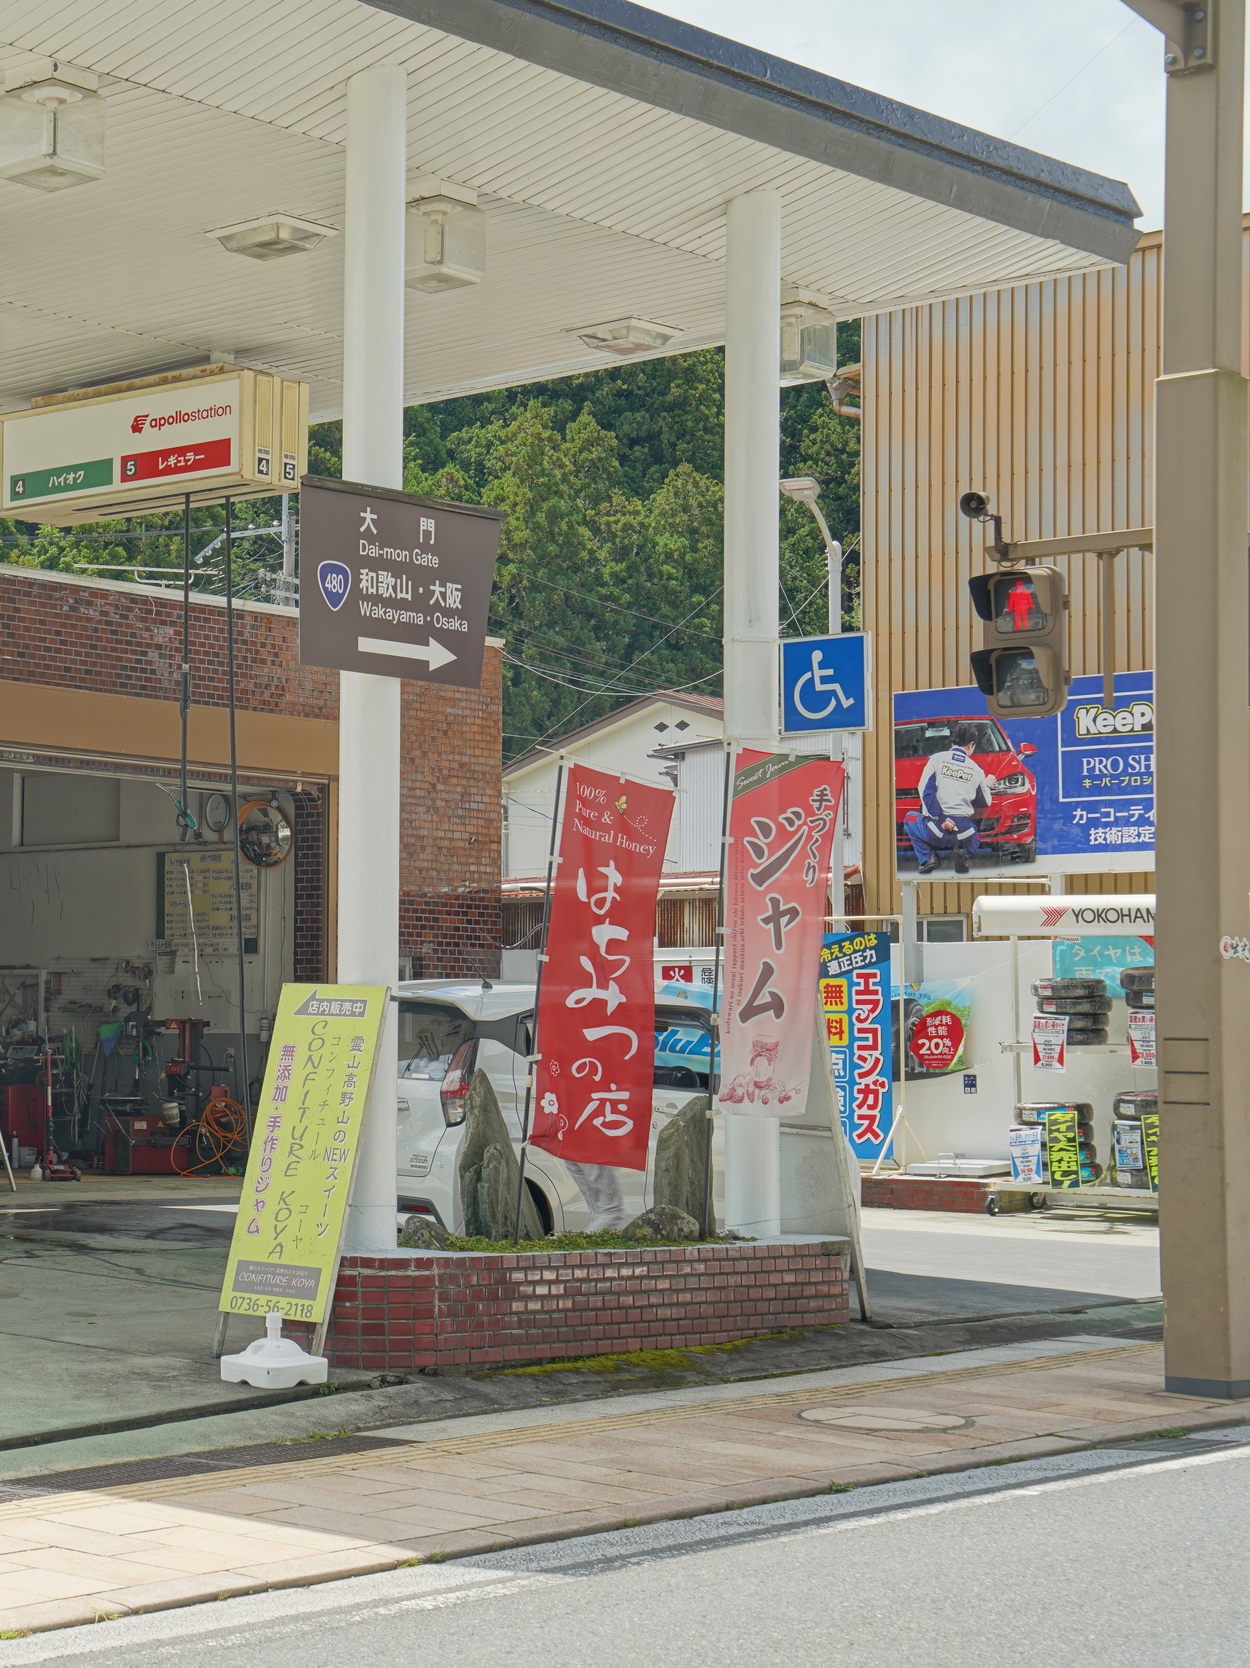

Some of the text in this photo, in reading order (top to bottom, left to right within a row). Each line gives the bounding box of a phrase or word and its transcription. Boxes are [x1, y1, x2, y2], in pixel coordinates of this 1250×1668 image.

[150, 403, 232, 431] apollostation
[126, 451, 205, 475] 5 レギュラー
[259, 459, 268, 474] 4
[285, 464, 294, 480] 5
[15, 470, 85, 494] 4 ハイオク
[359, 540, 439, 568] Dai-mon Gate
[325, 573, 344, 594] 480
[359, 568, 462, 610] 和歌山・大阪
[1076, 703, 1155, 736] KeeP
[736, 769, 763, 790] Sweet
[941, 765, 973, 781] KeePer
[1081, 756, 1124, 776] PRO
[575, 782, 607, 804] 100%
[1082, 775, 1152, 788] キーパープロシ
[575, 800, 614, 825] Pure &
[572, 818, 657, 859] Natural Honey
[805, 787, 834, 887] 手づくり
[1089, 826, 1155, 845] 技術認定
[738, 808, 807, 1025] ジャム
[820, 932, 877, 962] 冷えるのは
[670, 967, 685, 983] 火
[827, 949, 877, 976] 適正圧力
[307, 1000, 364, 1015] 店内販売中
[565, 859, 639, 1136] はちみつの店
[725, 1001, 733, 1034] kodawari
[729, 990, 735, 1000] no
[927, 1026, 948, 1037] 性能
[853, 970, 888, 1144] エアコンガス
[284, 1020, 328, 1178] CONFITURE
[309, 1036, 341, 1161] コンフィチュール
[246, 1043, 297, 1236] 無添加・手作りジャム
[316, 1036, 365, 1237] 霊山高野山のNEWスイーツ
[266, 1190, 295, 1260] KOYA
[292, 1204, 309, 1249] コーヤ
[238, 1272, 315, 1289] CONFITURE KOYA
[230, 1295, 314, 1319] 0736-56-2118
